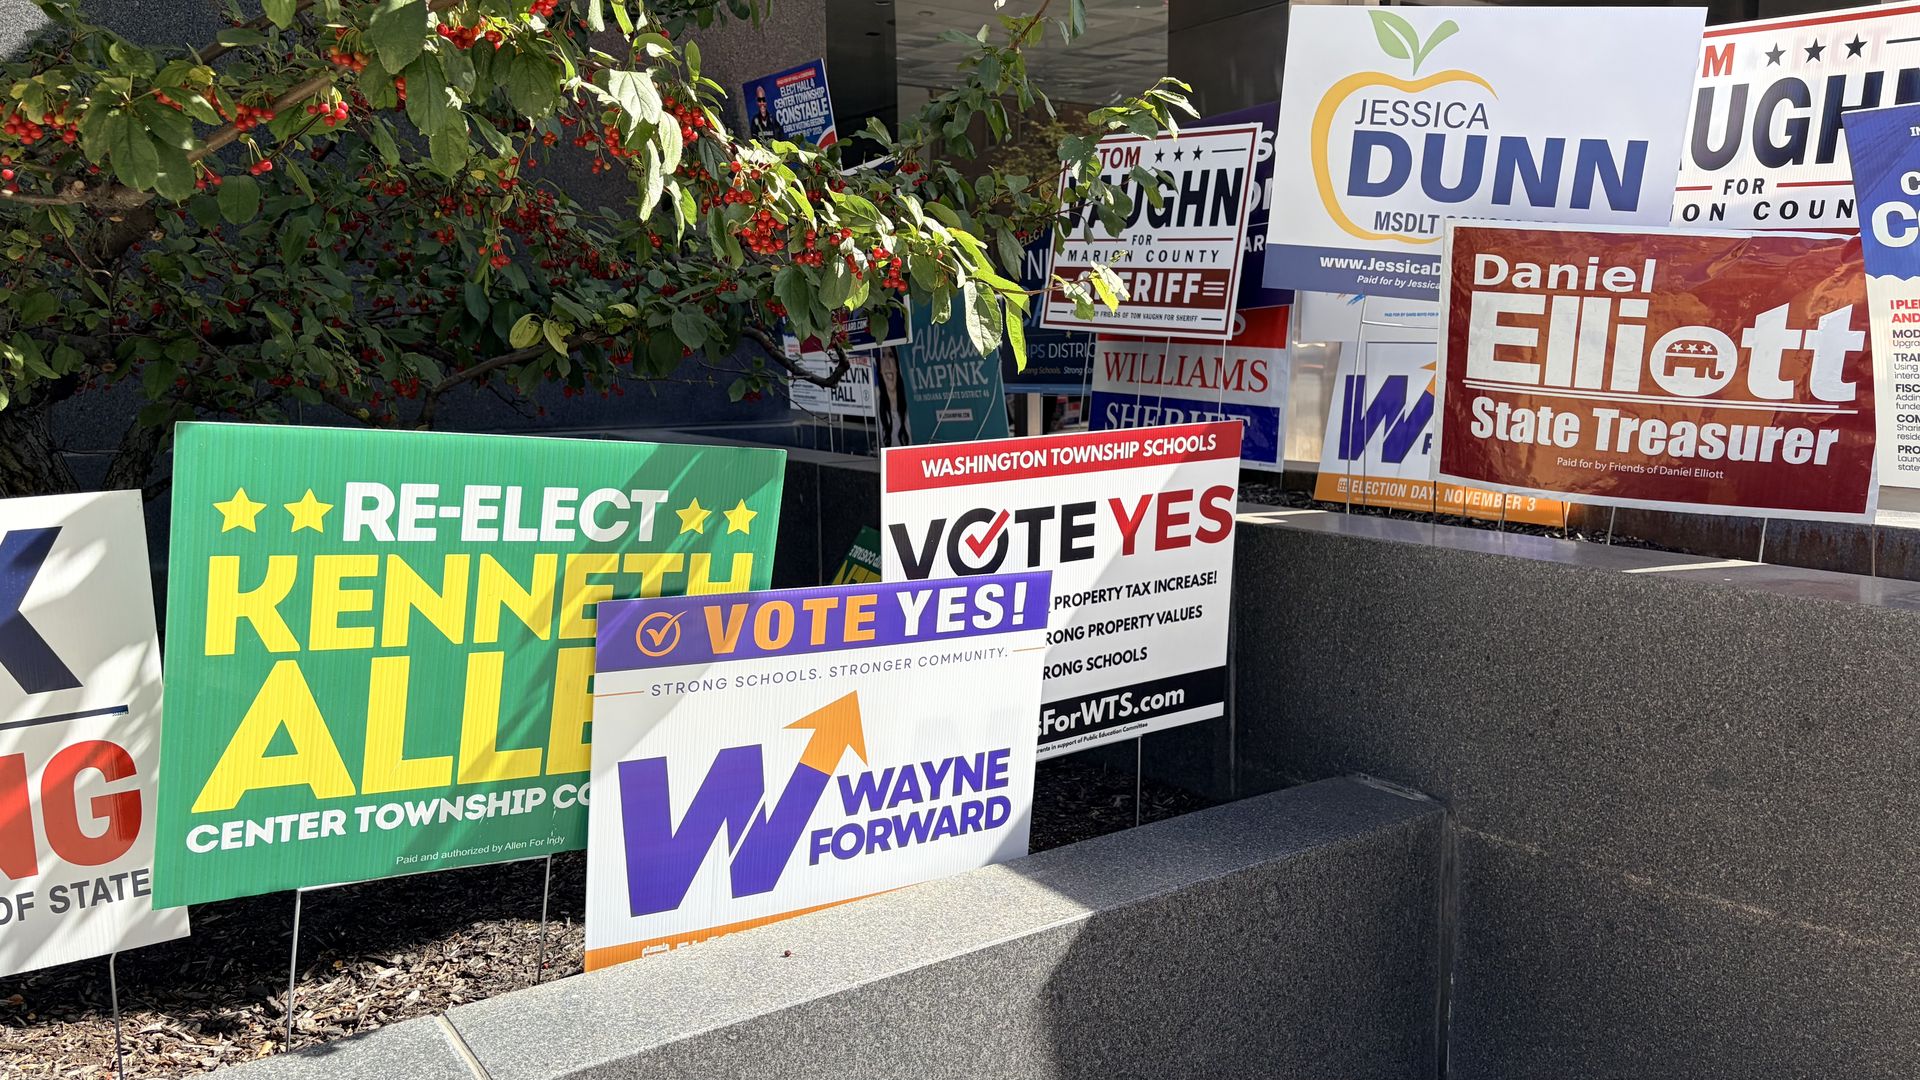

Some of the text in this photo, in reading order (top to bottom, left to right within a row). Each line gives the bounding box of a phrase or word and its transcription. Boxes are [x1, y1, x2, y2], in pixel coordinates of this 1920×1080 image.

[774, 86, 825, 110] CENTER TOWNSHIP
[780, 83, 797, 97] ELECT
[797, 79, 811, 92] HALL
[776, 98, 829, 126] CONSTABLE
[1355, 99, 1489, 130] JESSICA
[1690, 68, 1920, 171] UGH
[1100, 146, 1141, 169] TOM
[1347, 130, 1649, 212] DUNN
[1723, 178, 1765, 196] FOR
[1374, 211, 1439, 234] MSDLT
[1753, 199, 1854, 221] COUN
[1132, 234, 1153, 246] FOR
[1067, 250, 1220, 263] MARION COUNTY
[1320, 256, 1441, 276] www.JessicaD
[1078, 270, 1202, 304] SERIFF
[1357, 275, 1440, 290] Paid for by Jessica
[1474, 254, 1657, 294] Daniel
[1892, 313, 1920, 323] AND
[1896, 299, 1920, 310] PLE
[1175, 315, 1198, 323] SHERIFF
[1048, 342, 1096, 359] DISTRIC
[1466, 290, 1866, 402] Elliott
[829, 366, 870, 385] LVIN
[909, 360, 988, 390] IMPINK
[1063, 366, 1083, 376] Strong
[1104, 351, 1268, 393] WILLIAMS
[1894, 363, 1919, 373] Using
[830, 386, 856, 402] HALL
[961, 390, 982, 399] DISTRICT
[1895, 384, 1920, 393] FISC
[1470, 396, 1580, 449] State
[1592, 407, 1839, 466] Treasurer
[921, 433, 1217, 478] WASHINGTON TOWNSHIP SCHOOLS
[1898, 445, 1920, 454] PRO
[1556, 457, 1724, 479] Paid for by Friends of Daniel Elliott
[1351, 479, 1406, 498] ELECTION
[1444, 487, 1522, 510] NOVEMBER
[1527, 497, 1536, 512] 3
[342, 482, 669, 542] RE-ELECT
[888, 485, 1235, 580] VOTE YES
[1054, 586, 1123, 611] PROPERTY
[1125, 581, 1151, 598] TAX
[1154, 570, 1218, 594] INCREASE!
[703, 581, 1028, 655] VOTE YES!
[1046, 605, 1203, 646] RONG PROPERTY VALUES
[651, 647, 1008, 697] STRONG SCHOOLS. STRONGER COMMUNITY.
[1043, 647, 1148, 681] RONG SCHOOLS
[191, 646, 597, 813] ALLE
[1057, 740, 1077, 750] support
[1083, 733, 1098, 743] Public
[1098, 728, 1123, 739] Education
[1122, 722, 1149, 733] Committee
[836, 748, 1011, 817] WAYNE
[186, 809, 346, 854] CENTER
[355, 787, 546, 834] TOWNSHIP
[808, 795, 1012, 866] FORWARD
[396, 835, 565, 864] Paid and authorized by Allen For Indy
[49, 868, 151, 914] STATE
